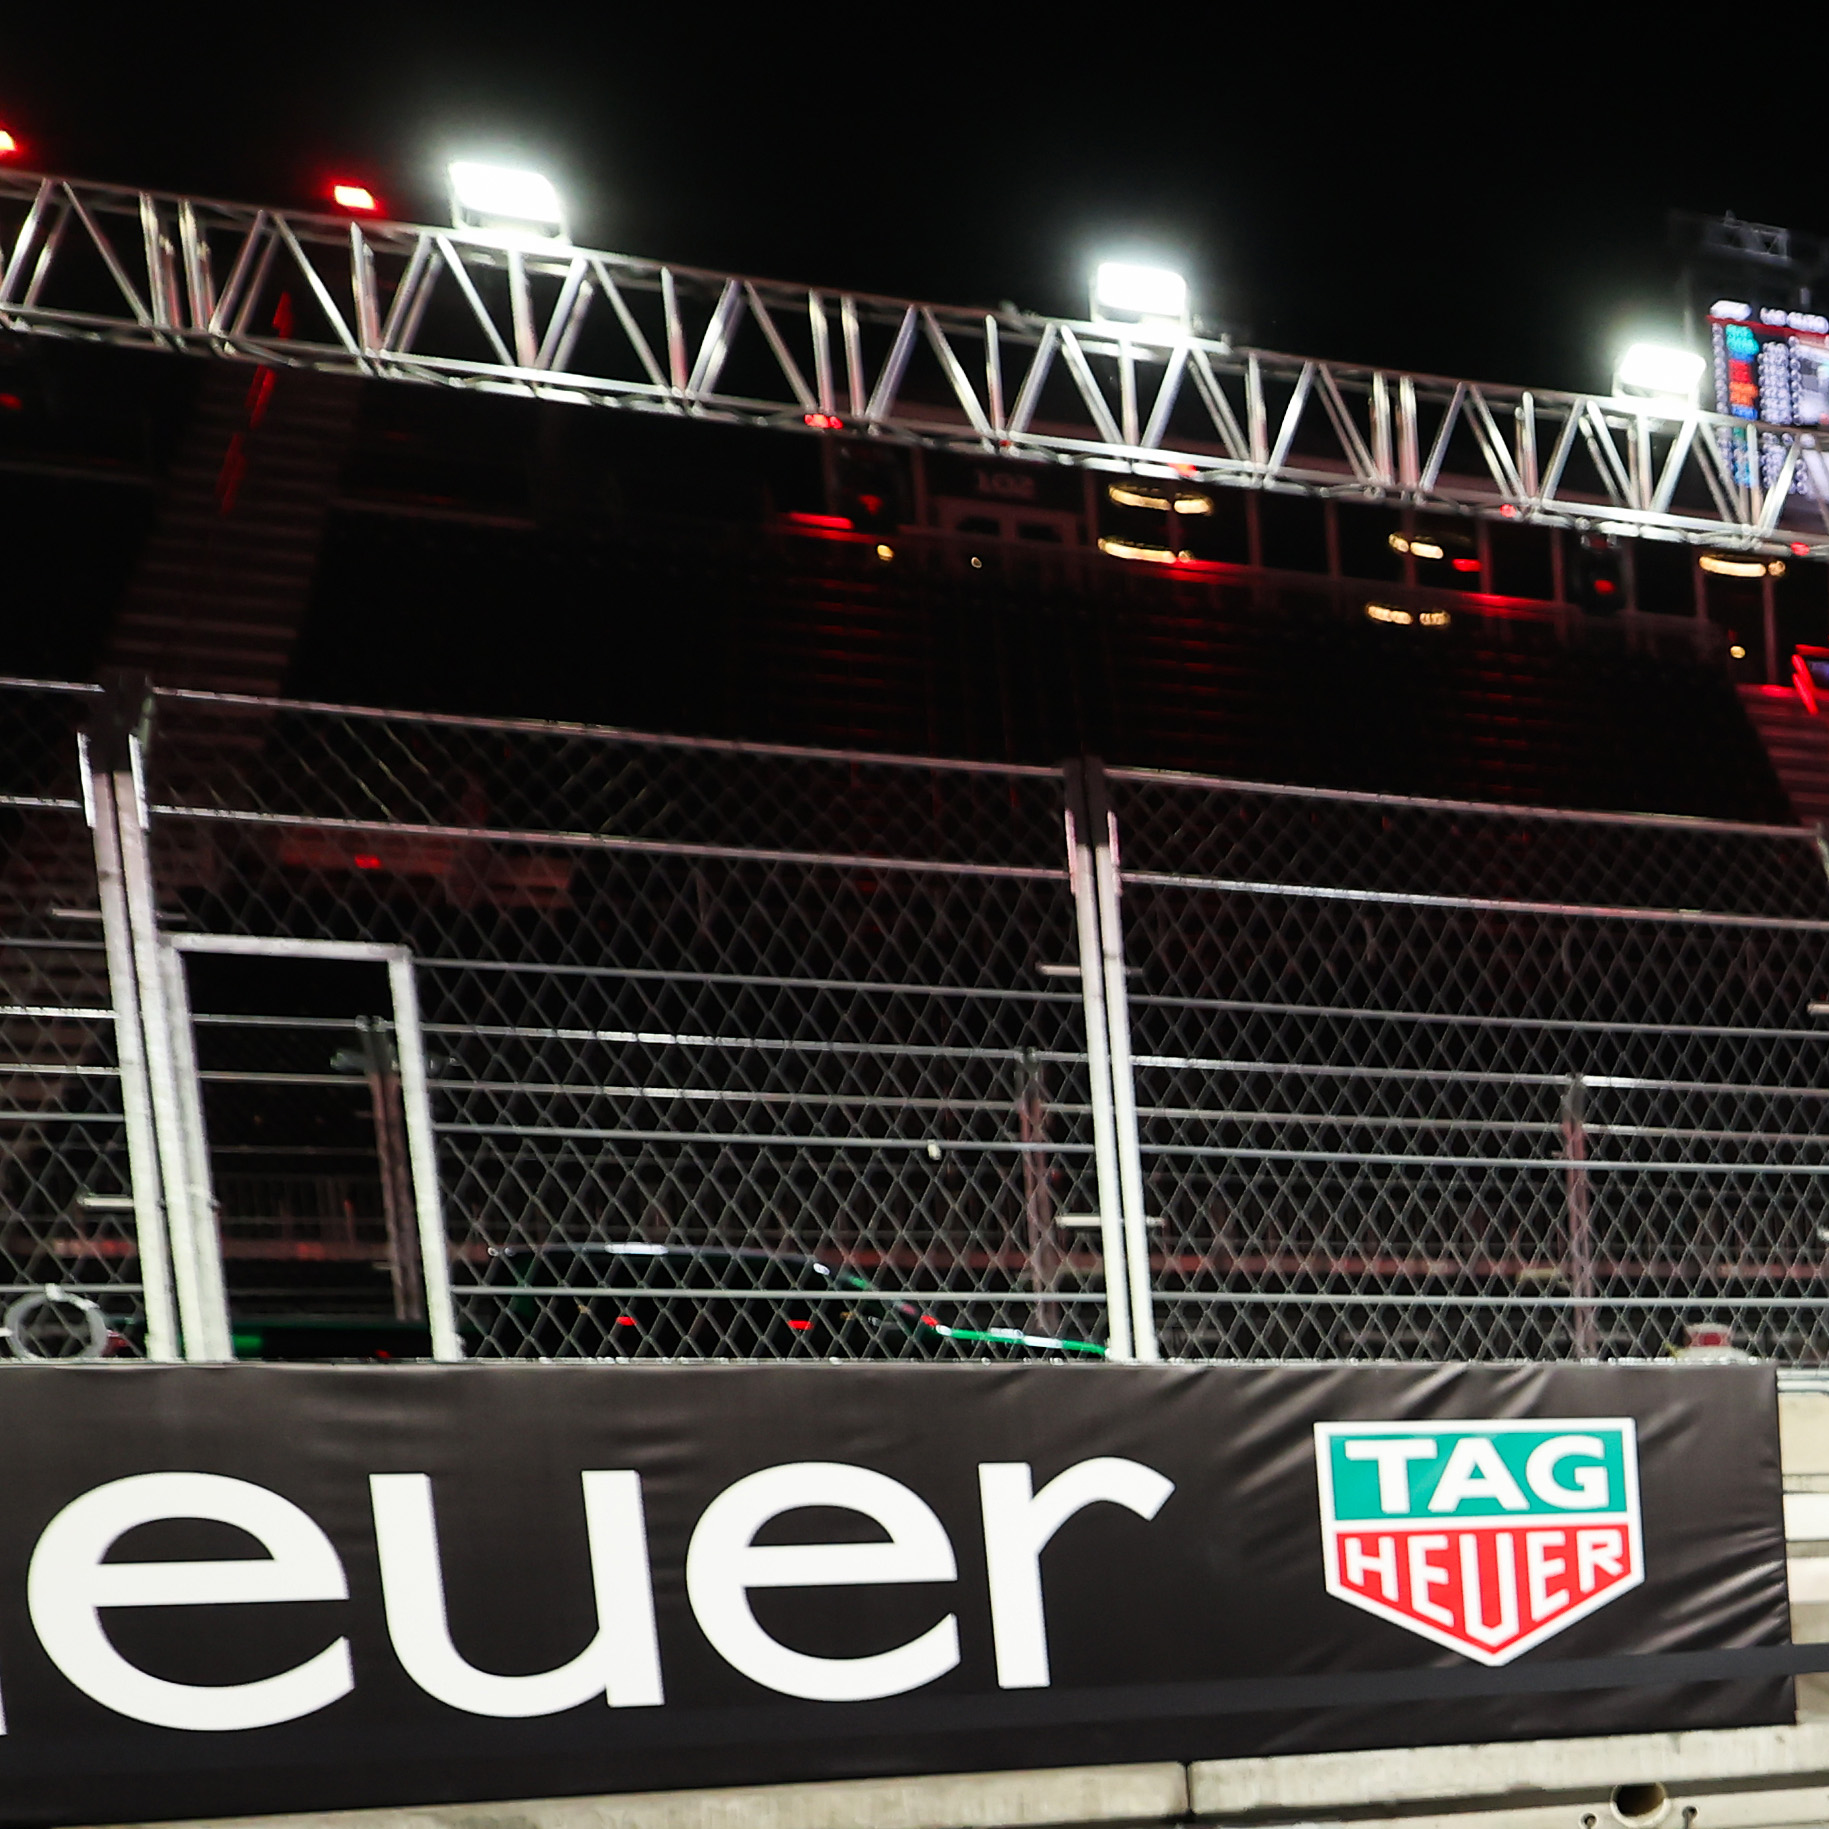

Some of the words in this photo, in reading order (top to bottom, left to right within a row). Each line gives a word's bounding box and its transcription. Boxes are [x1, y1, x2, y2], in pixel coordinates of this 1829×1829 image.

[1344, 1434, 1611, 1515] TAG
[0, 1457, 1175, 1733] euer
[1344, 1528, 1624, 1647] HEUER
